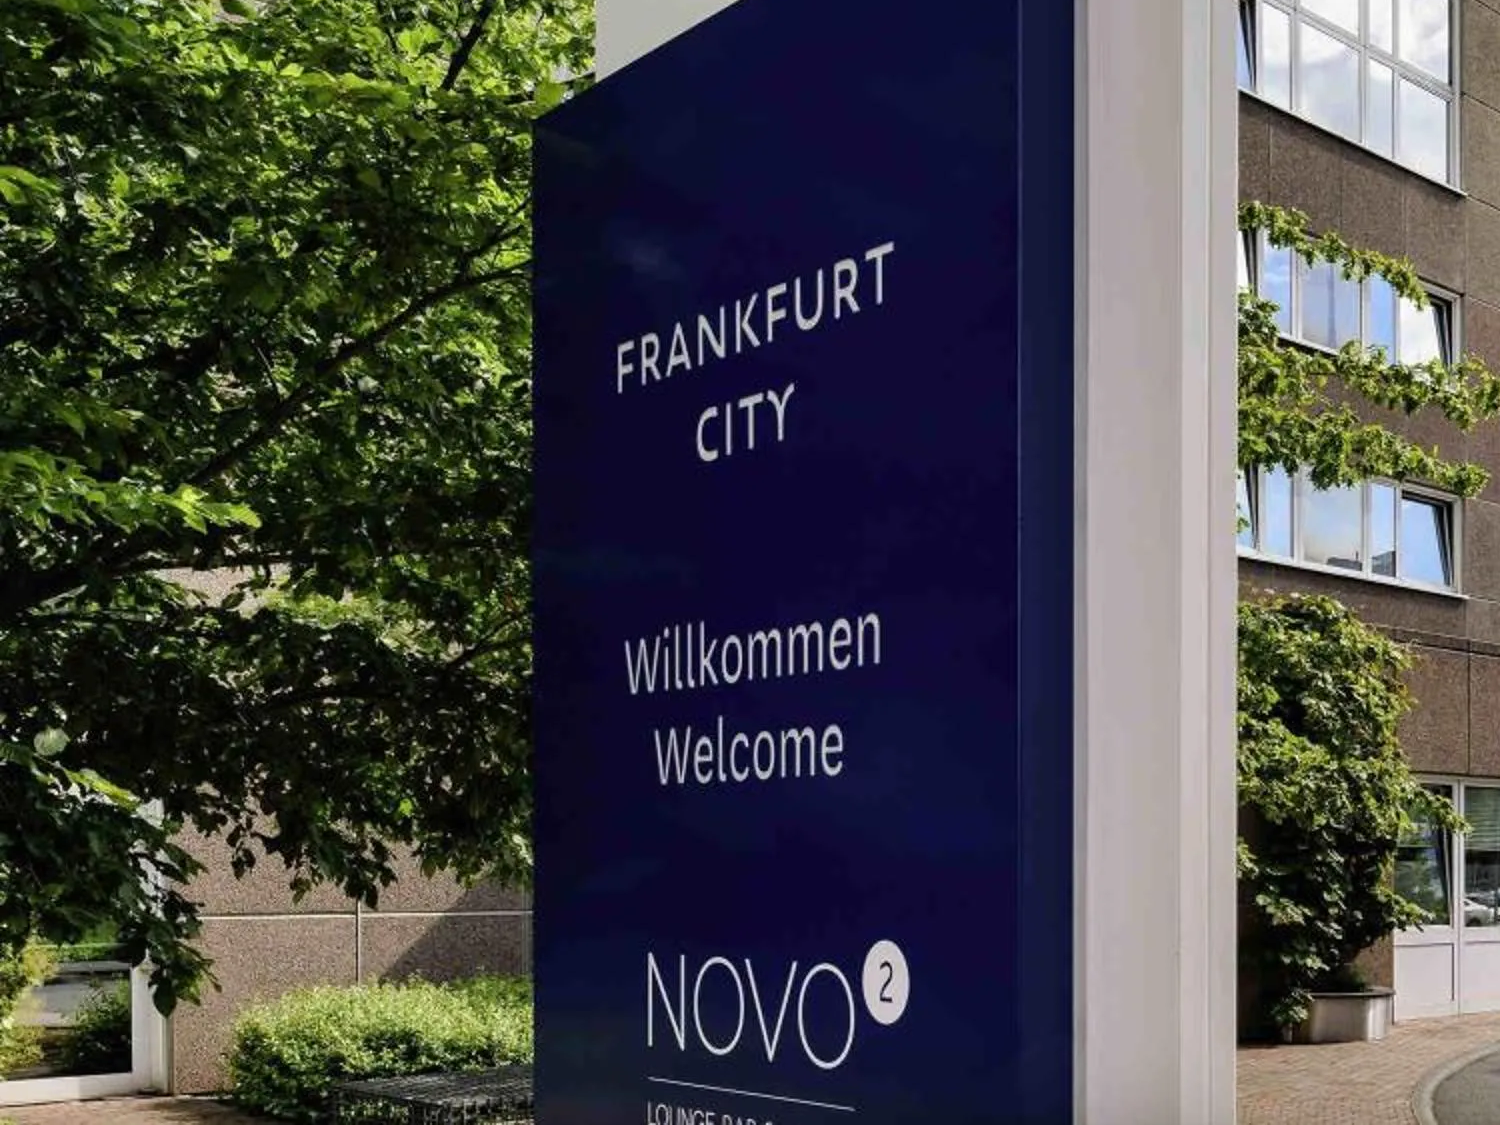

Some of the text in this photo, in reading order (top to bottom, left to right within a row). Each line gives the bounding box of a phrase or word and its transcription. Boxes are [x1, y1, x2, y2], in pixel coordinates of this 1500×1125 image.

[616, 241, 895, 394] FRANKFURT
[696, 383, 795, 462] CITY
[624, 612, 881, 695] Willkommen
[654, 715, 844, 786] Welcome
